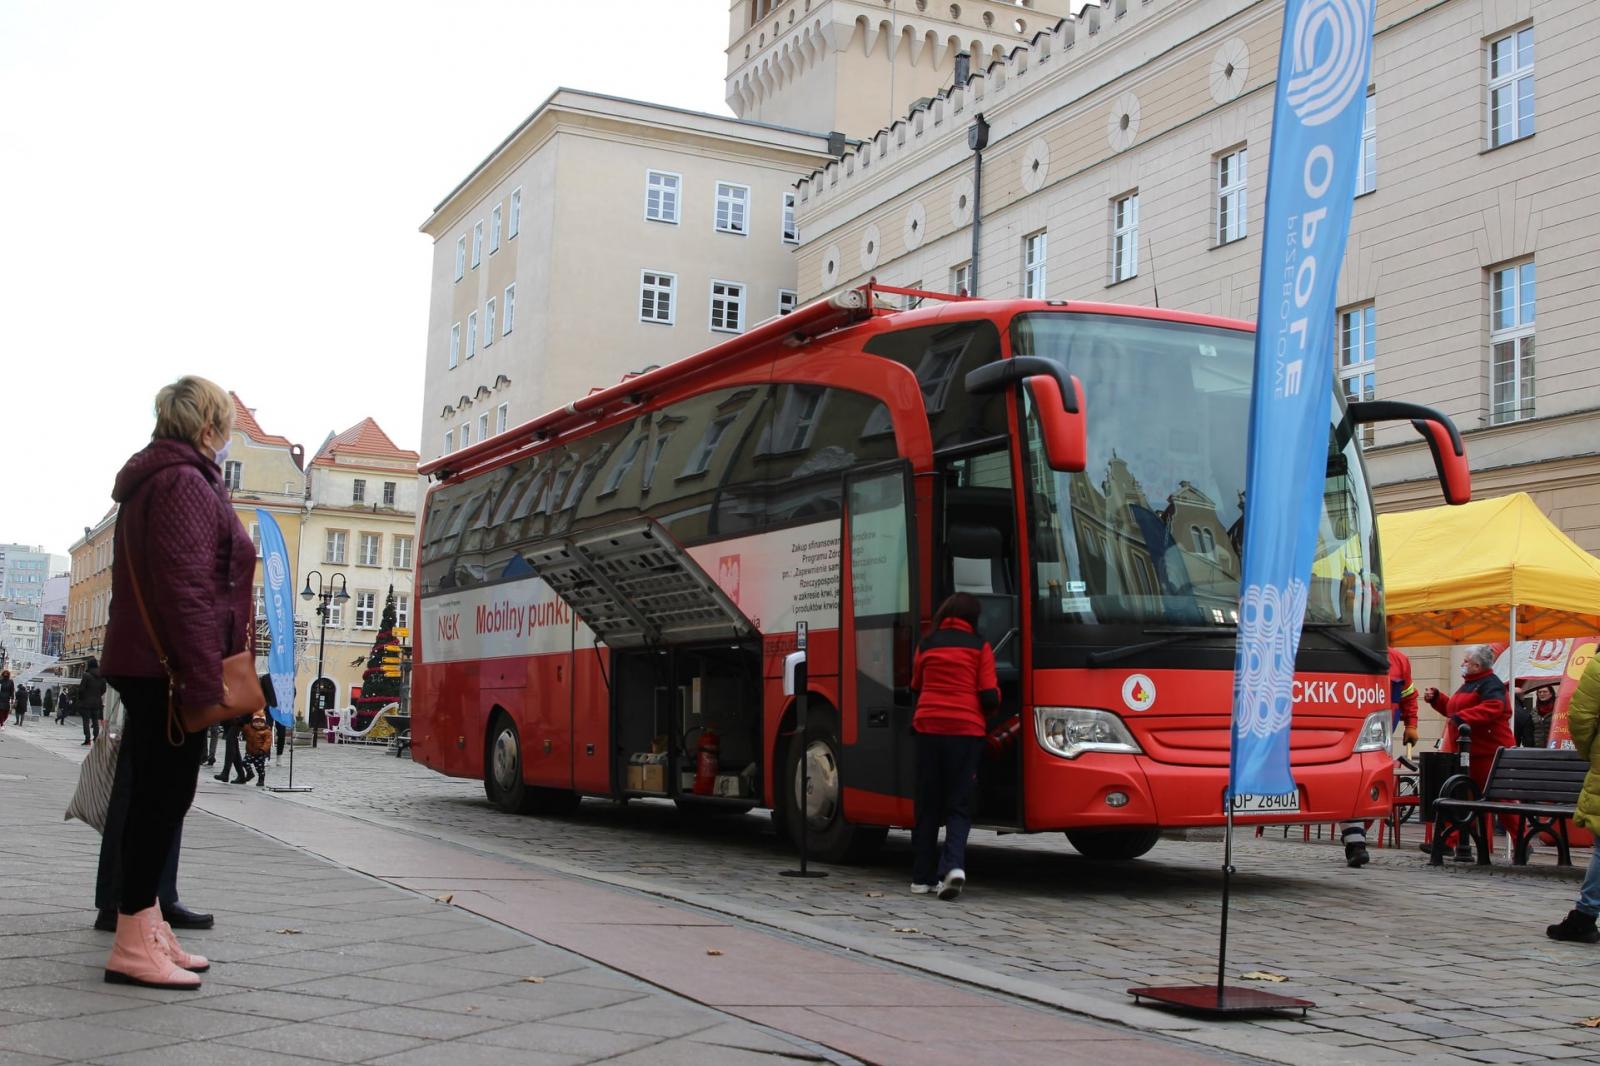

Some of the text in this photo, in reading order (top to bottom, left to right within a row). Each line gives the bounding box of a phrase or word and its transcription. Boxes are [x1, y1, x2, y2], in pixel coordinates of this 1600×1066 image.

[792, 538, 841, 553] Zakup sfinansowan
[802, 549, 841, 564] Programu Zdro
[273, 595, 285, 654] OPOLE
[476, 600, 525, 638] Mobilny
[528, 594, 570, 636] punkt
[1292, 681, 1385, 709] CKiK Opole
